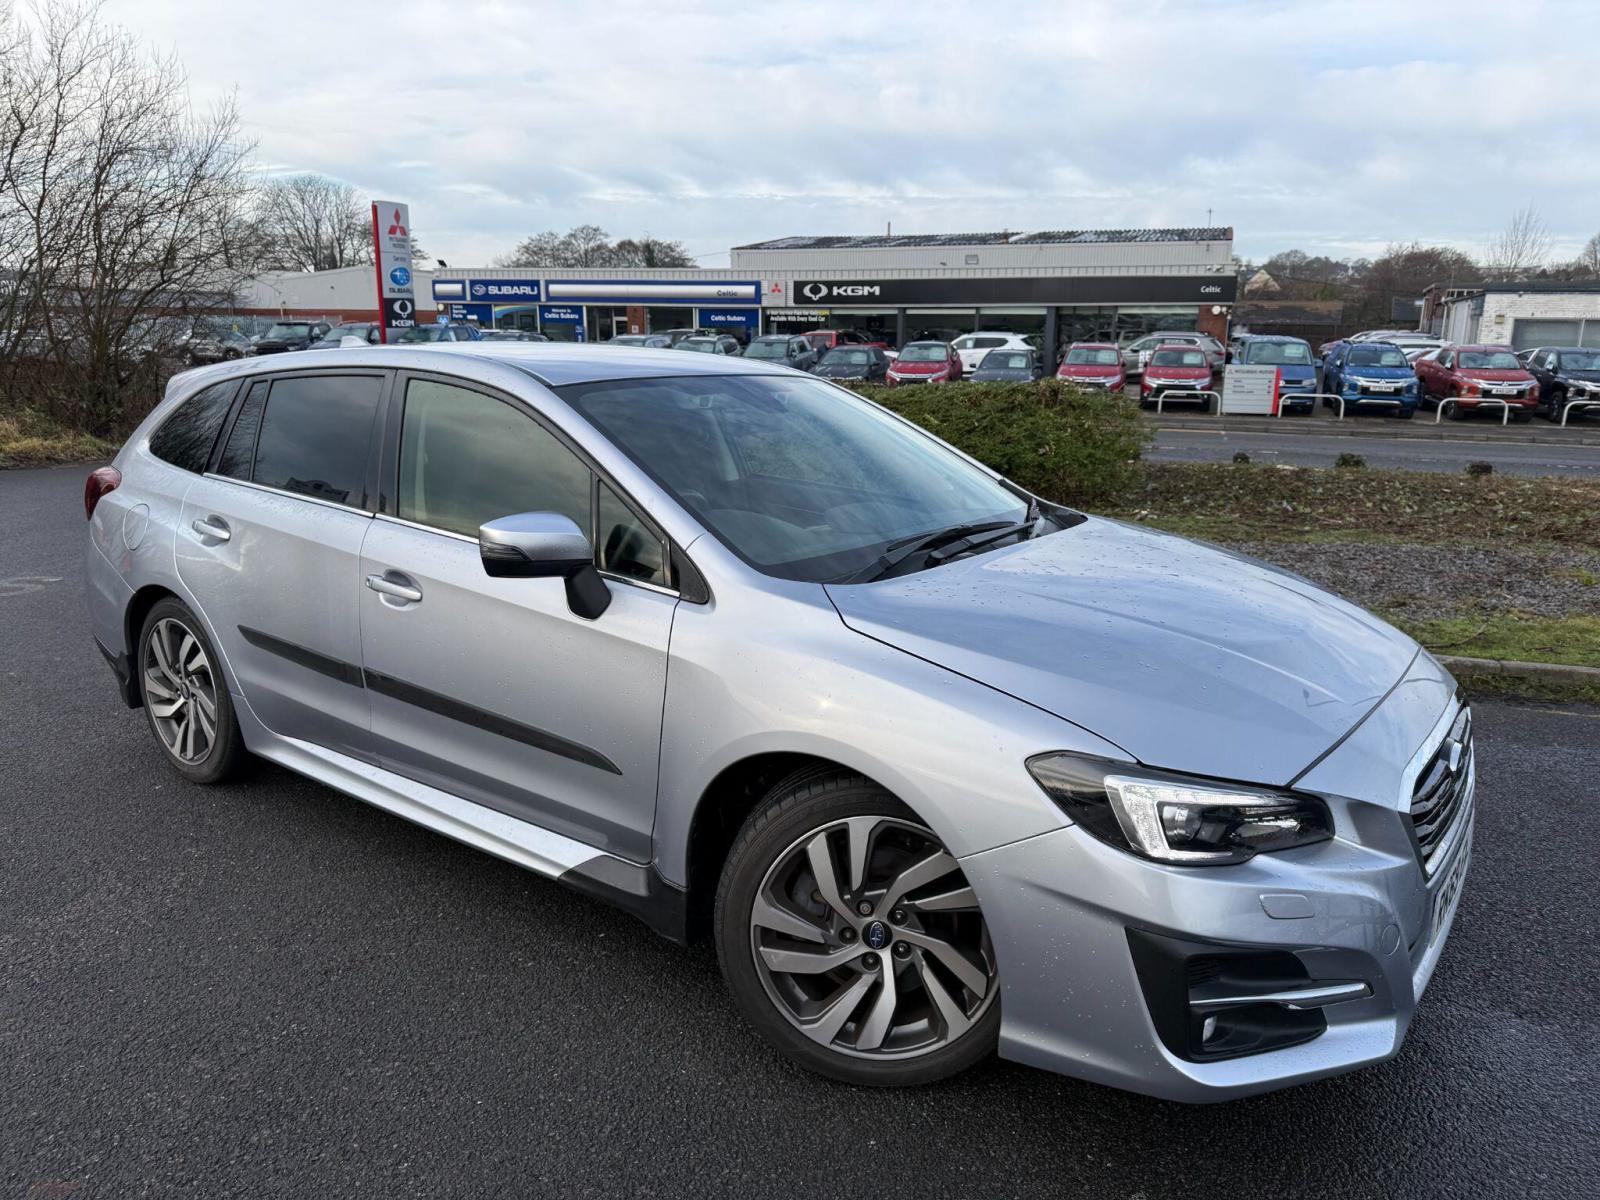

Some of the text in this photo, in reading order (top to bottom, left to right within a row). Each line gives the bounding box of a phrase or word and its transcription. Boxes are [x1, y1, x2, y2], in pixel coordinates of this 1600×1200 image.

[488, 285, 538, 295] SUBARU
[716, 289, 738, 297] Celtic
[832, 285, 880, 296] KGM
[1200, 285, 1222, 293] Celtic
[560, 312, 579, 320] Subaru
[710, 314, 746, 322] Celtic Subaru
[391, 319, 415, 328] KGM
